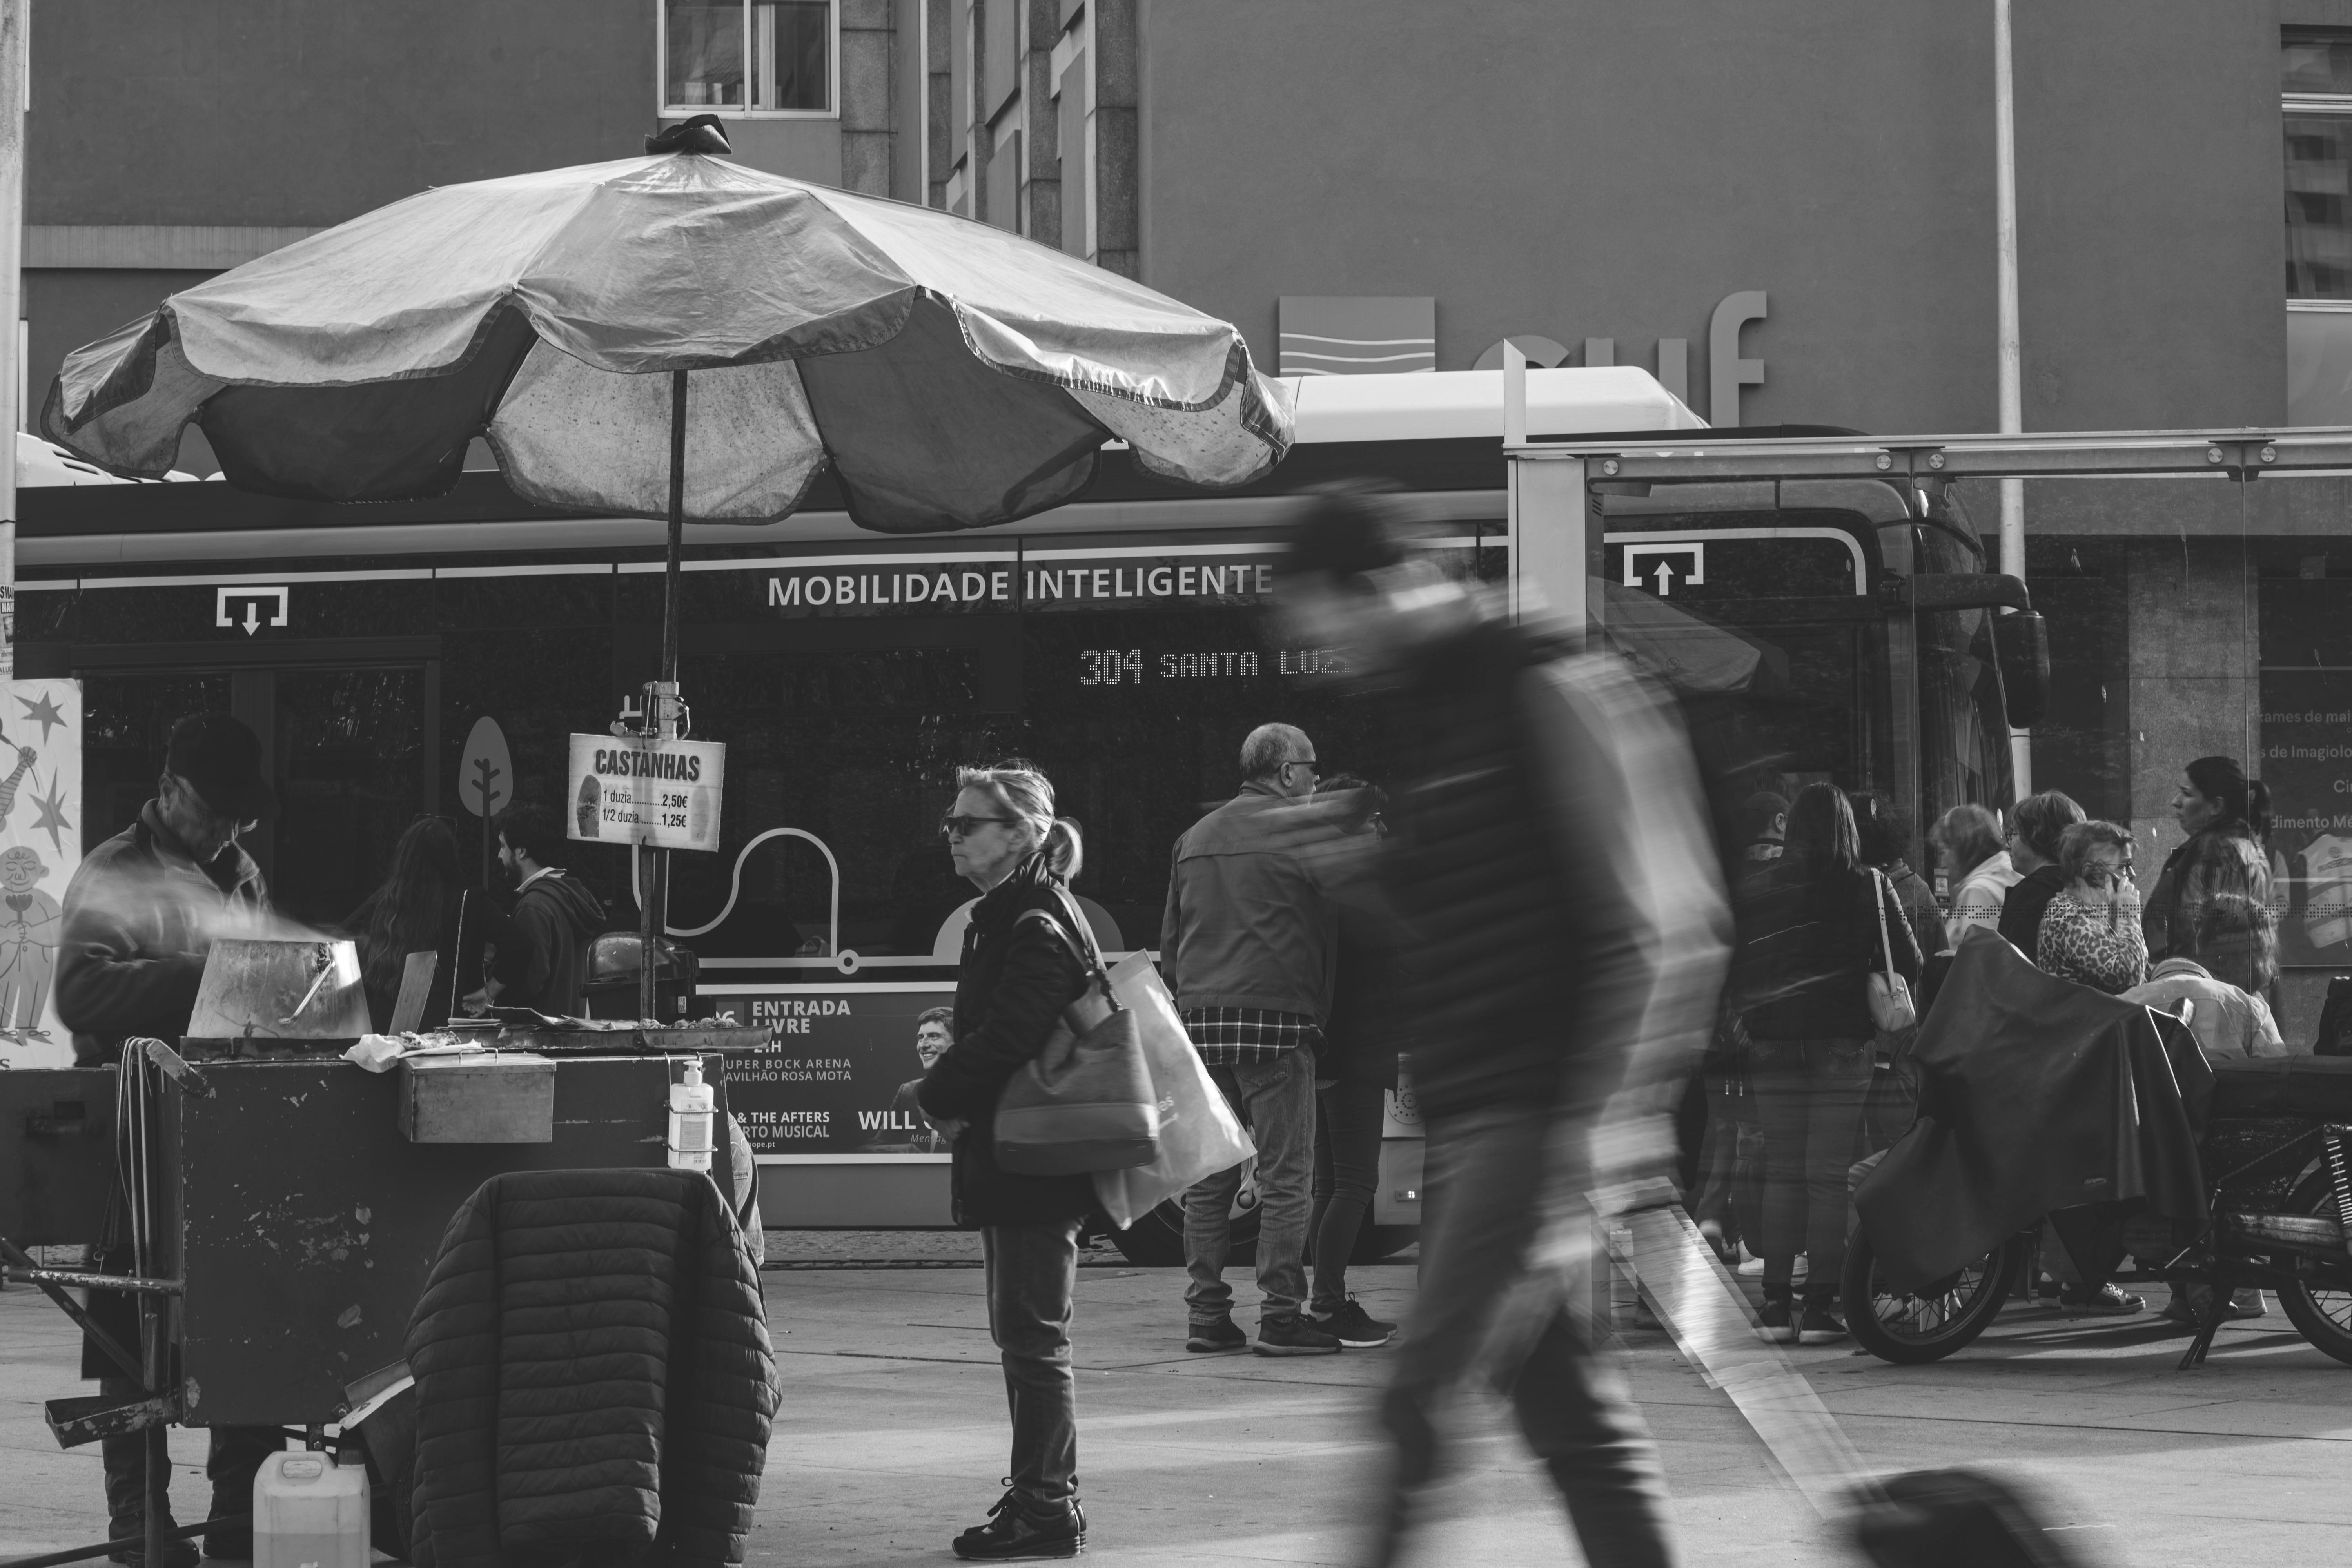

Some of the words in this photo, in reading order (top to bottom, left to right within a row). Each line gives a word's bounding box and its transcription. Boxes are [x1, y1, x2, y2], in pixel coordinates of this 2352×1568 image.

[769, 572, 1008, 606] MOBILIDADE
[1027, 564, 1273, 599] INTELIGENTE
[1081, 649, 1143, 685] 304
[1160, 652, 1258, 677] SANTA
[2305, 710, 2323, 723] de
[2270, 744, 2288, 758] de
[2292, 744, 2352, 762] Imagiolo
[595, 749, 700, 782] CASTANHAS
[603, 789, 607, 801] 1
[610, 789, 632, 804] duzia
[662, 794, 688, 808] 2,50€
[603, 808, 615, 822] 1/2
[618, 810, 639, 824] duzia
[662, 813, 687, 828] 1,25€
[753, 1000, 851, 1016] ENTRADA
[726, 1059, 760, 1069] UPER
[765, 1059, 801, 1069] BOCK
[806, 1059, 851, 1069] ARENA
[725, 1069, 778, 1082] AVILHÃO
[782, 1071, 813, 1081] ROSA
[817, 1071, 852, 1081] MOTA
[737, 1112, 747, 1123] &
[751, 1112, 777, 1123] THE
[780, 1112, 830, 1123] AFTERS
[858, 1111, 916, 1130] WILL
[740, 1125, 768, 1138] RTO
[772, 1125, 830, 1138] MUSICAL
